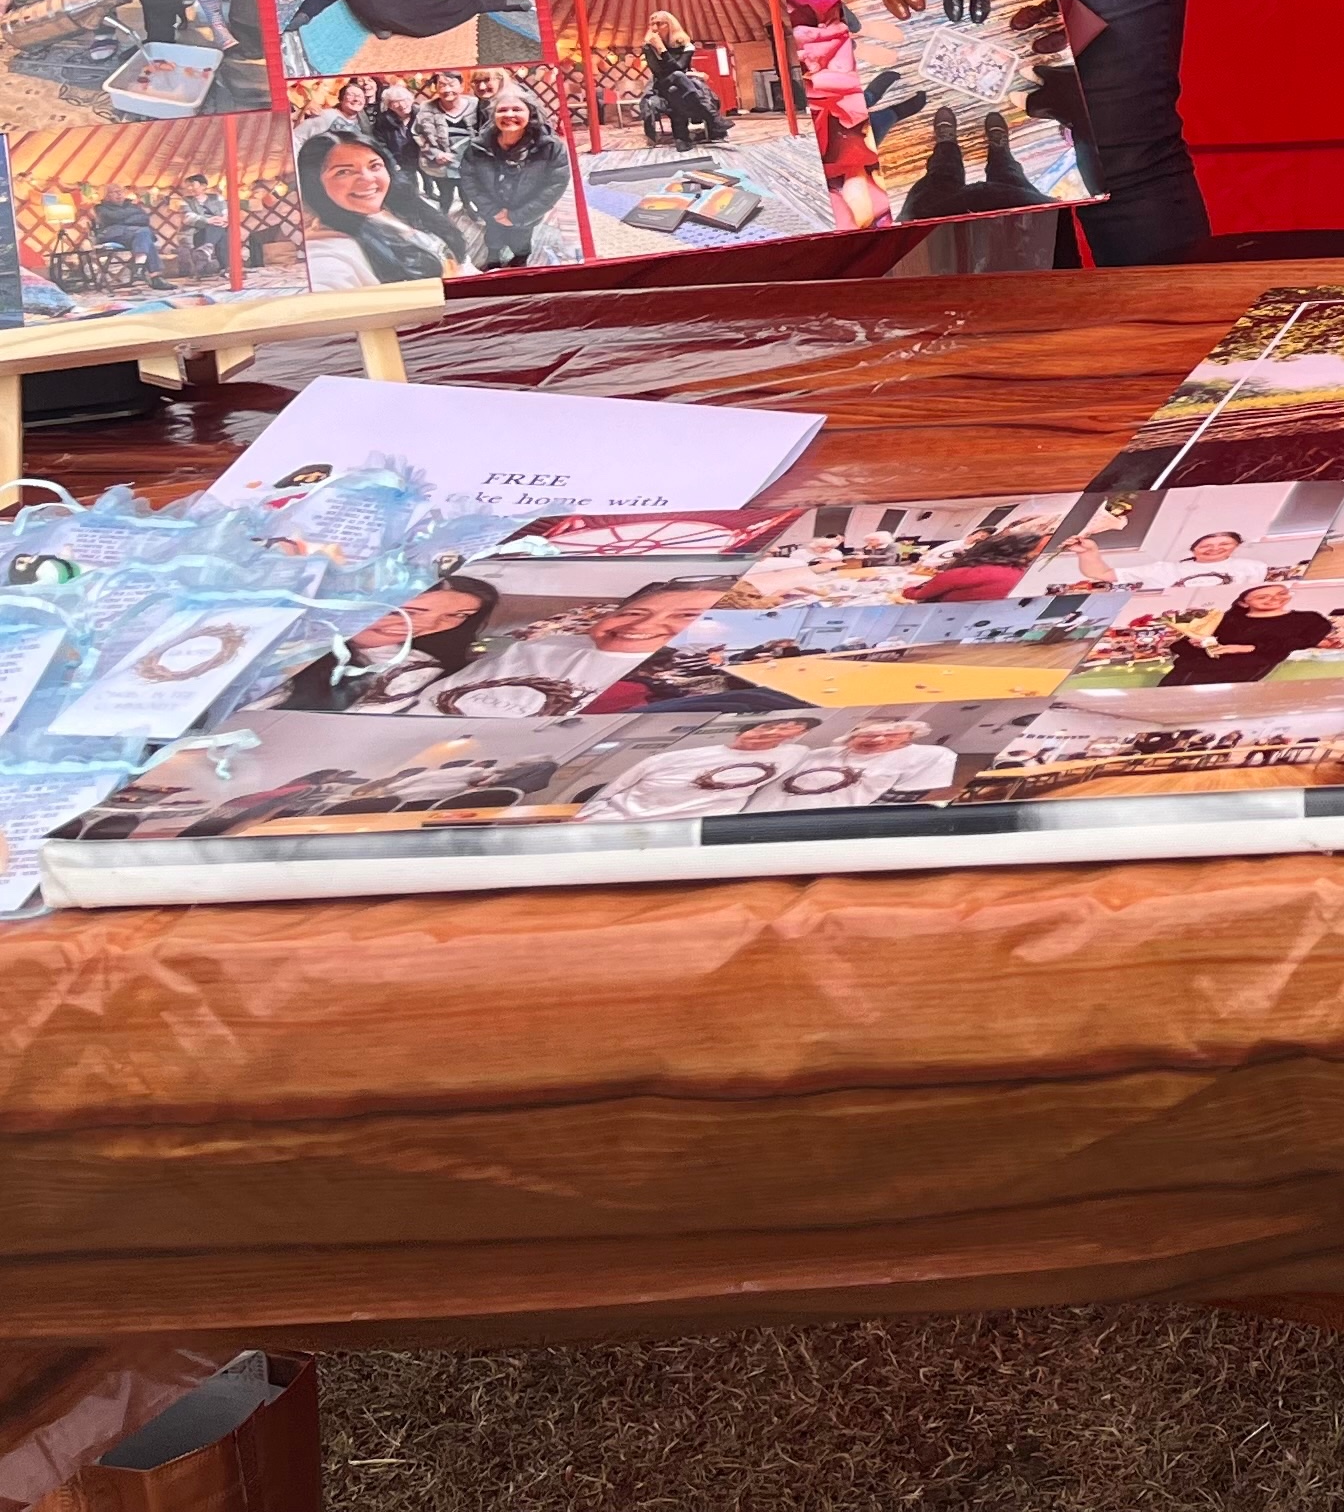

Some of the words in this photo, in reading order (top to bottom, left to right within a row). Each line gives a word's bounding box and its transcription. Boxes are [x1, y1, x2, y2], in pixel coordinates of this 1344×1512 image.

[482, 472, 571, 487] FREE
[513, 492, 593, 506] home
[608, 495, 669, 507] with
